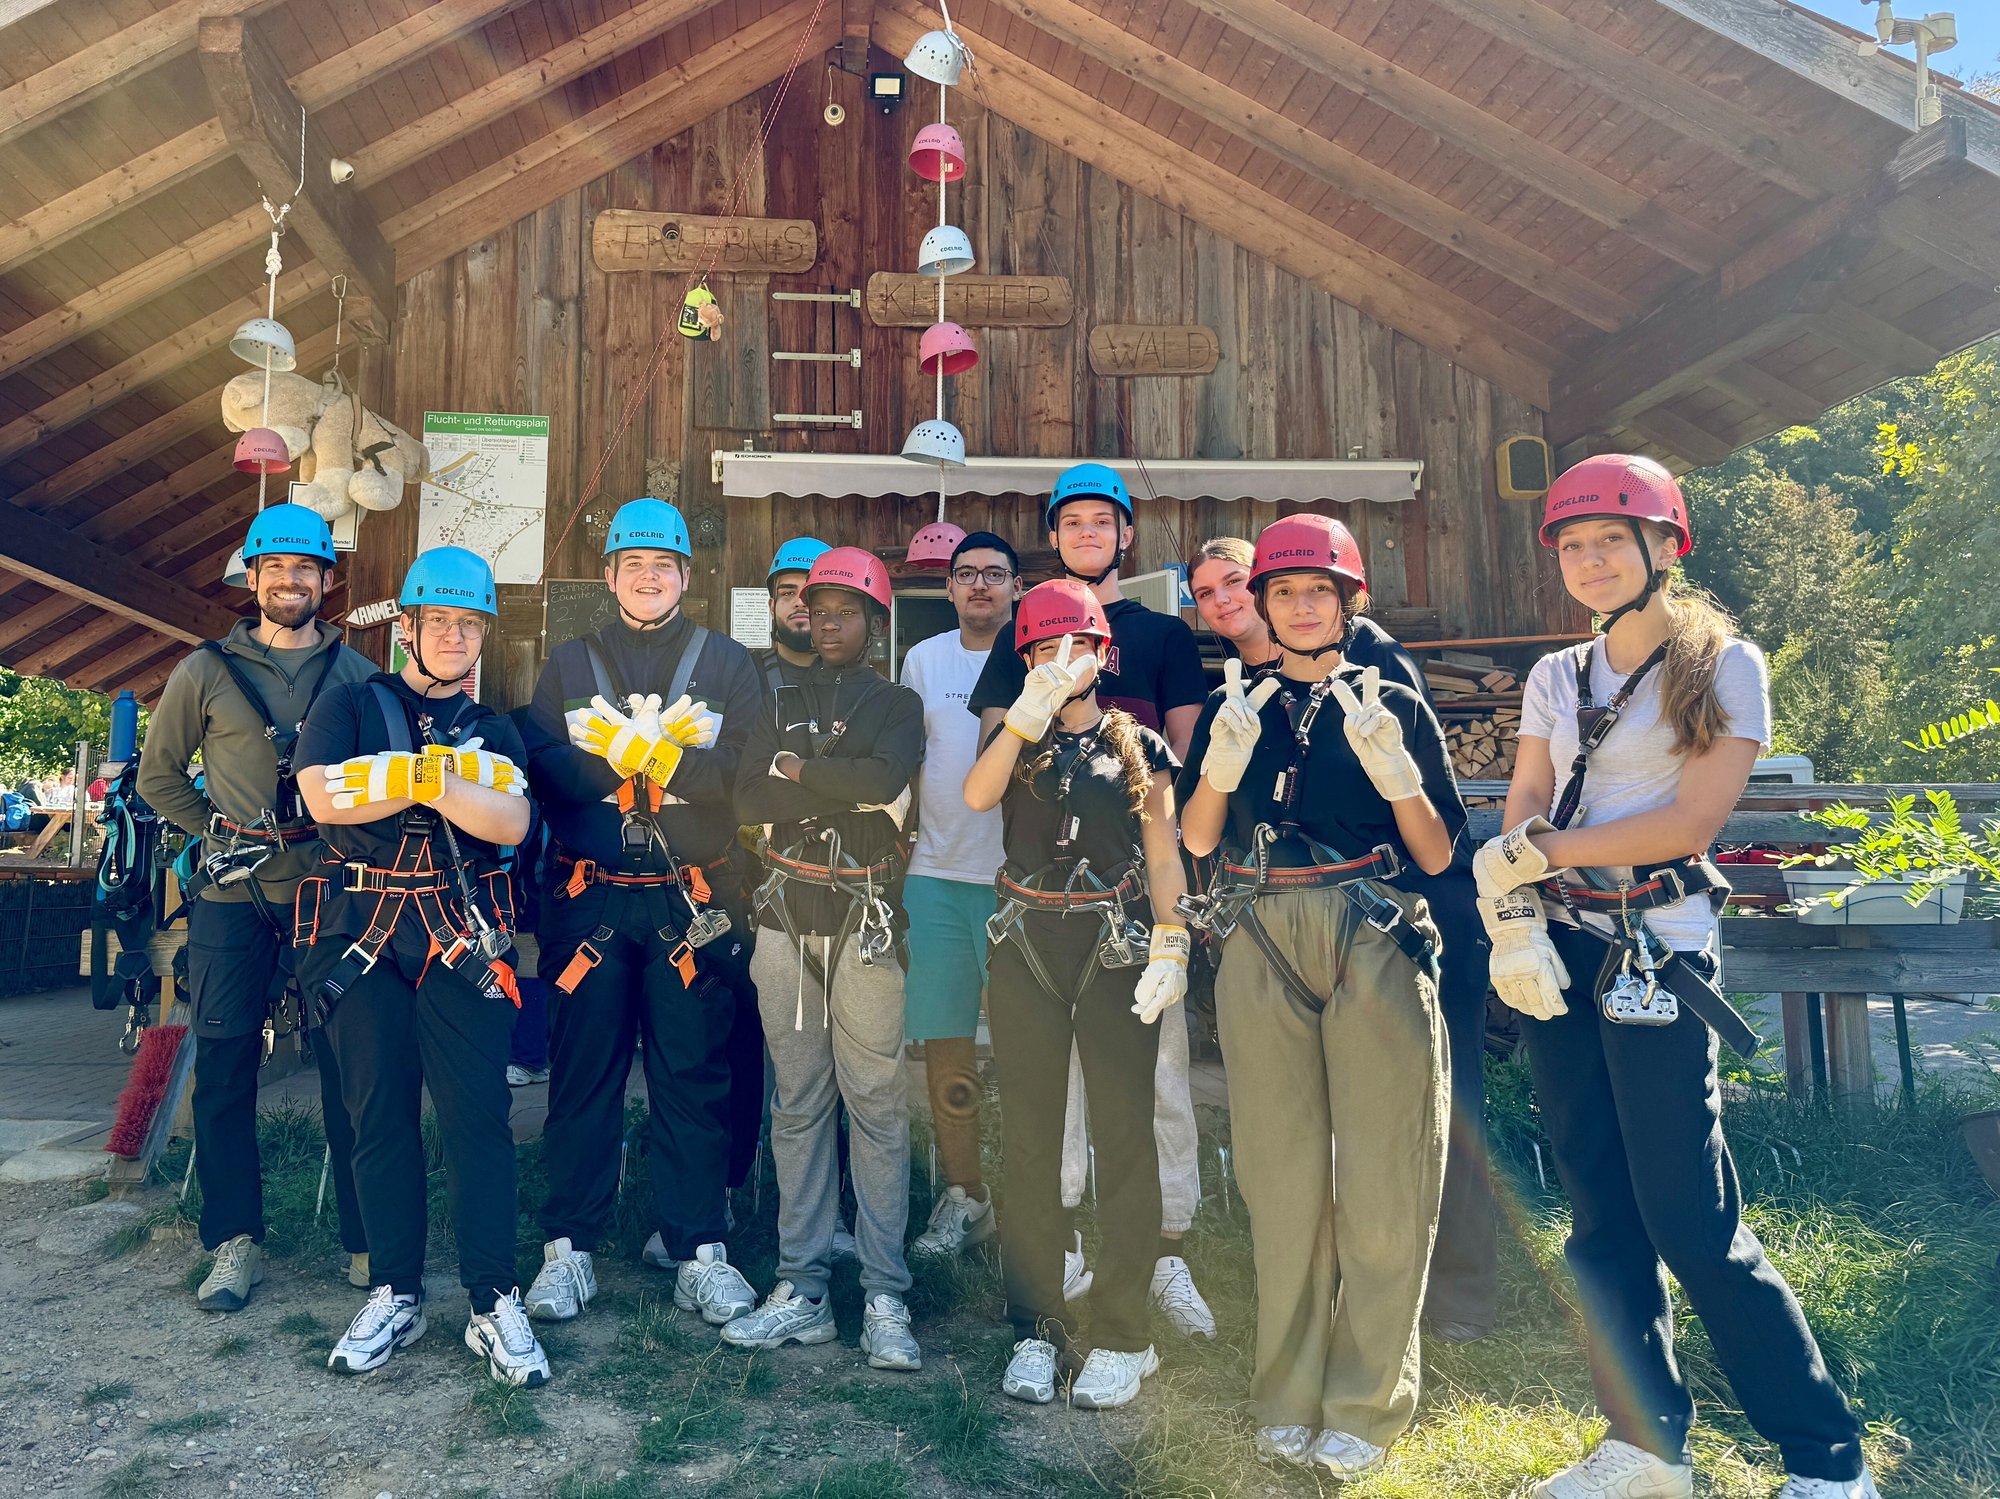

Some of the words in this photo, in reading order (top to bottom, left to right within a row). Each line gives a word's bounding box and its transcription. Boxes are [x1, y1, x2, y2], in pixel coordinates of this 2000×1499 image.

[882, 282, 1054, 320] KLETTER
[1104, 330, 1212, 371] WALD
[427, 414, 461, 425] Flucht-
[463, 416, 482, 426] und
[484, 417, 547, 429] Rettungsplan
[1067, 481, 1102, 490] EDELRID
[1552, 494, 1600, 511] EDELRID
[271, 536, 311, 545] EDELRID
[629, 531, 665, 539] EDELRID
[1268, 548, 1315, 561] EDELRID
[818, 569, 854, 579] EDELRID
[434, 587, 475, 599] EDELRID
[1039, 616, 1079, 628] EDELRID
[1267, 876, 1323, 884] MAMMUT
